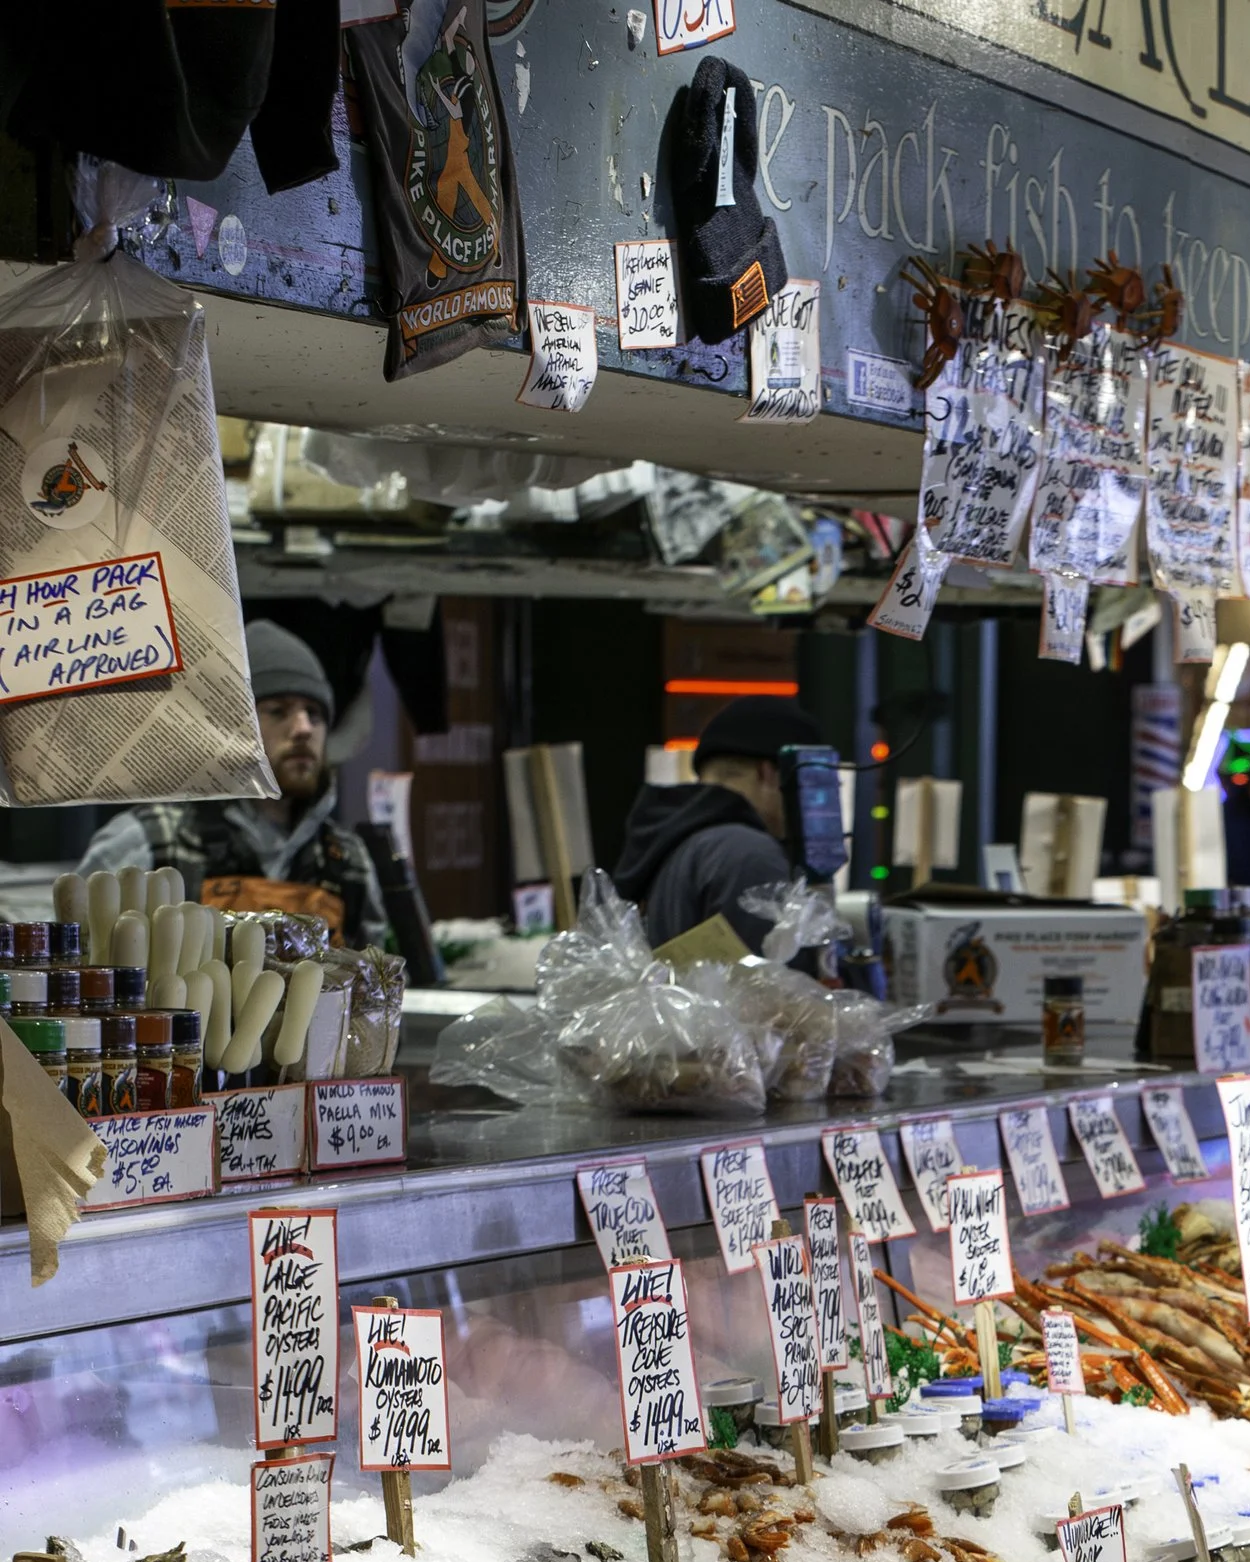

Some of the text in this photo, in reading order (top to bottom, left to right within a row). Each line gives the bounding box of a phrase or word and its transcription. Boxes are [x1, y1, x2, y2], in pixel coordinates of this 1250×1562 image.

[409, 127, 425, 203] PIKE
[421, 204, 472, 265] PLACE
[475, 82, 499, 212] MARKET
[821, 99, 957, 275] pack
[978, 122, 1082, 285] fish
[1093, 168, 1142, 270] to
[402, 285, 513, 331] WORLD FAMOUS
[27, 559, 159, 605] HOUR PACK
[7, 592, 148, 636] IN A BAG
[317, 1083, 395, 1100] WORLD FAMOUS
[107, 1110, 208, 1138] PLACE FISH MARKET
[318, 1102, 397, 1123] PAELLA MIX
[101, 1131, 182, 1160] EASONINGS
[327, 1124, 375, 1155] $9.00
[713, 1147, 752, 1178] FRESH
[152, 1170, 174, 1193] EA.
[590, 1167, 628, 1197] FRESH
[716, 1177, 765, 1208] PETRALE
[588, 1196, 655, 1231] TRUE COD
[260, 1215, 312, 1257] LIVE!
[262, 1258, 325, 1295] LARGE
[768, 1241, 803, 1281] WILD
[620, 1263, 674, 1307] LIVE!
[262, 1294, 325, 1332] PACIFIC
[367, 1313, 406, 1347] LIVE!
[616, 1305, 688, 1349] TREASURE
[780, 1314, 813, 1339] SPOT
[265, 1326, 321, 1366] OYSTERS
[631, 1340, 674, 1374] COVE
[365, 1346, 443, 1390] KUMAMOTO
[376, 1387, 423, 1419] OYSTERS
[628, 1369, 681, 1404] OYSTERS
[629, 1390, 684, 1446] $14.99
[391, 1452, 411, 1467] USA
[657, 1439, 677, 1454] USA
